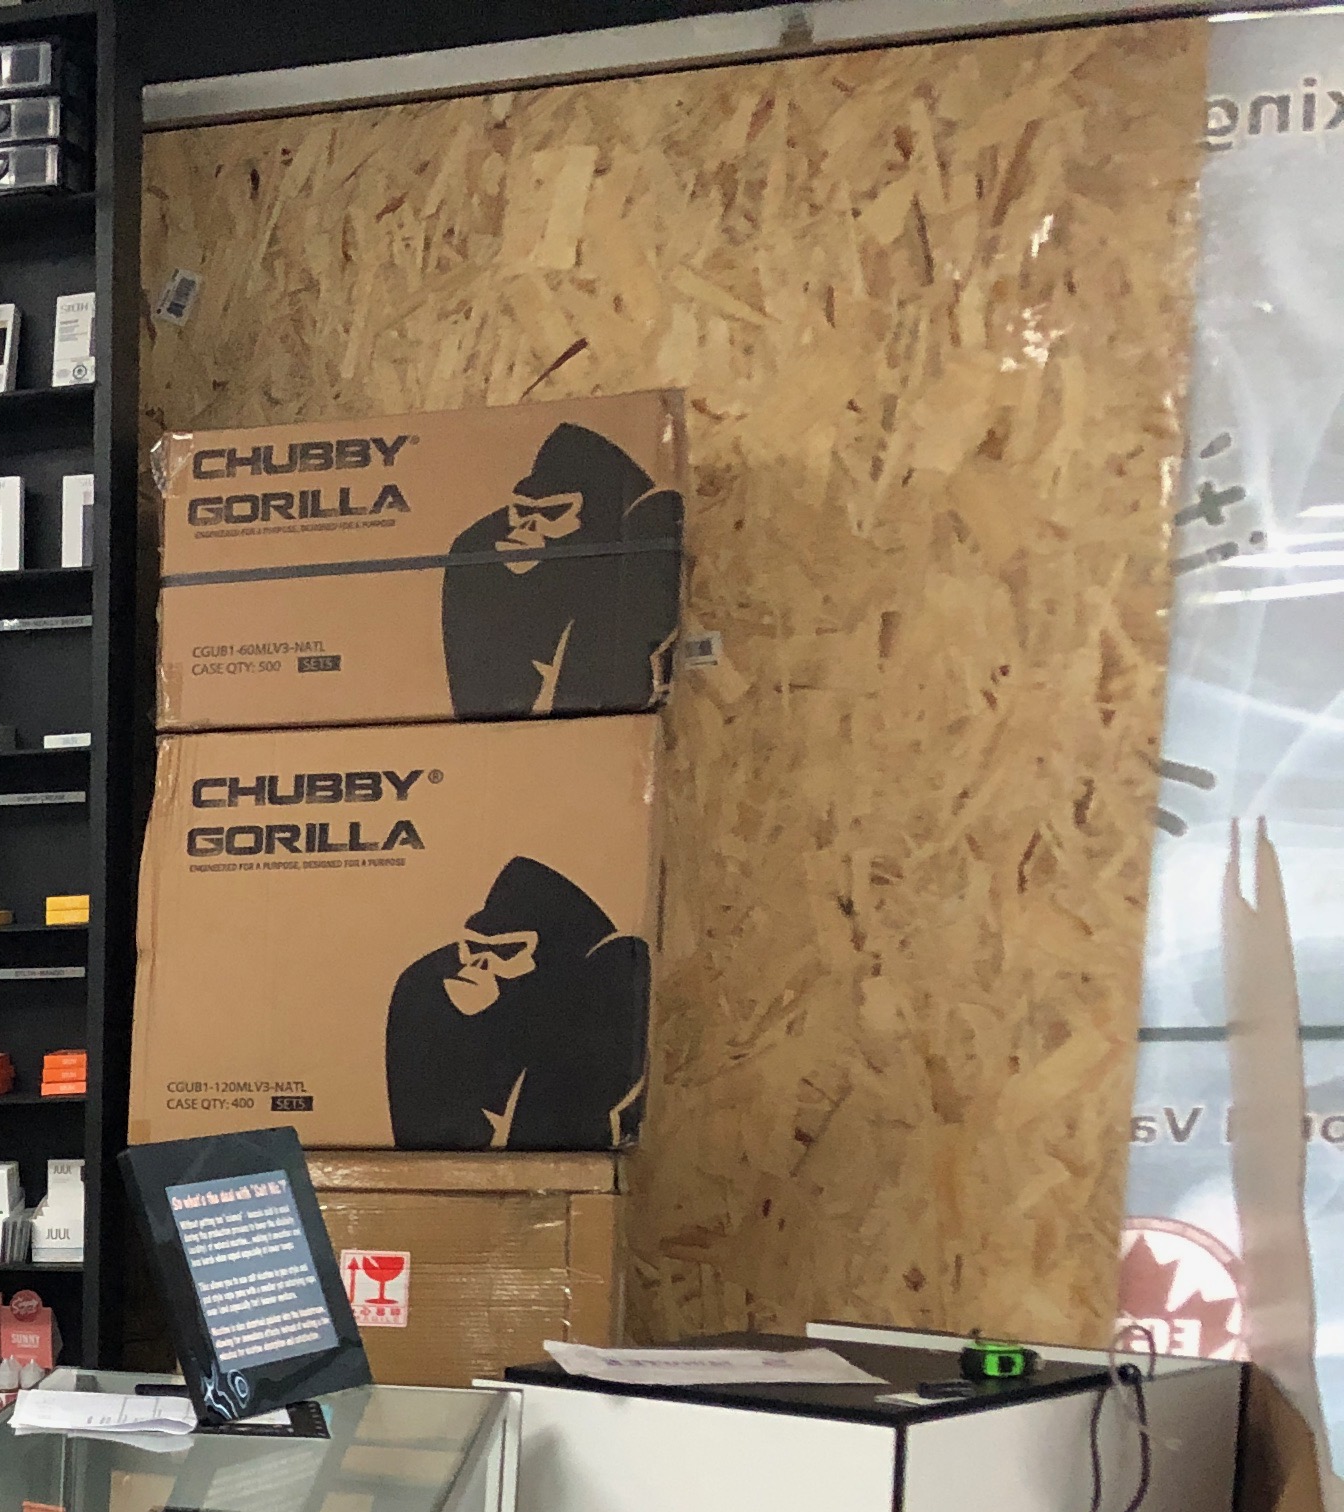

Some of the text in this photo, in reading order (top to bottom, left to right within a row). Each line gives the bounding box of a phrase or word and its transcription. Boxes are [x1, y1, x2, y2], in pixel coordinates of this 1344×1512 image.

[192, 435, 408, 480] CHUBBY
[188, 484, 411, 526] GORILLA
[192, 640, 325, 659] CGUB1-60MLV3-NATL
[191, 657, 334, 676] CASE QTY: 500 SETS
[192, 769, 424, 809] CHUBBY
[186, 819, 426, 857] GORILLA
[166, 1081, 308, 1093] CGUB1-120MLV3-NATL
[166, 1097, 306, 1111] CASE QTY: 400 SETS
[46, 1228, 71, 1240] JUUL
[12, 1333, 40, 1344] SUNNY
